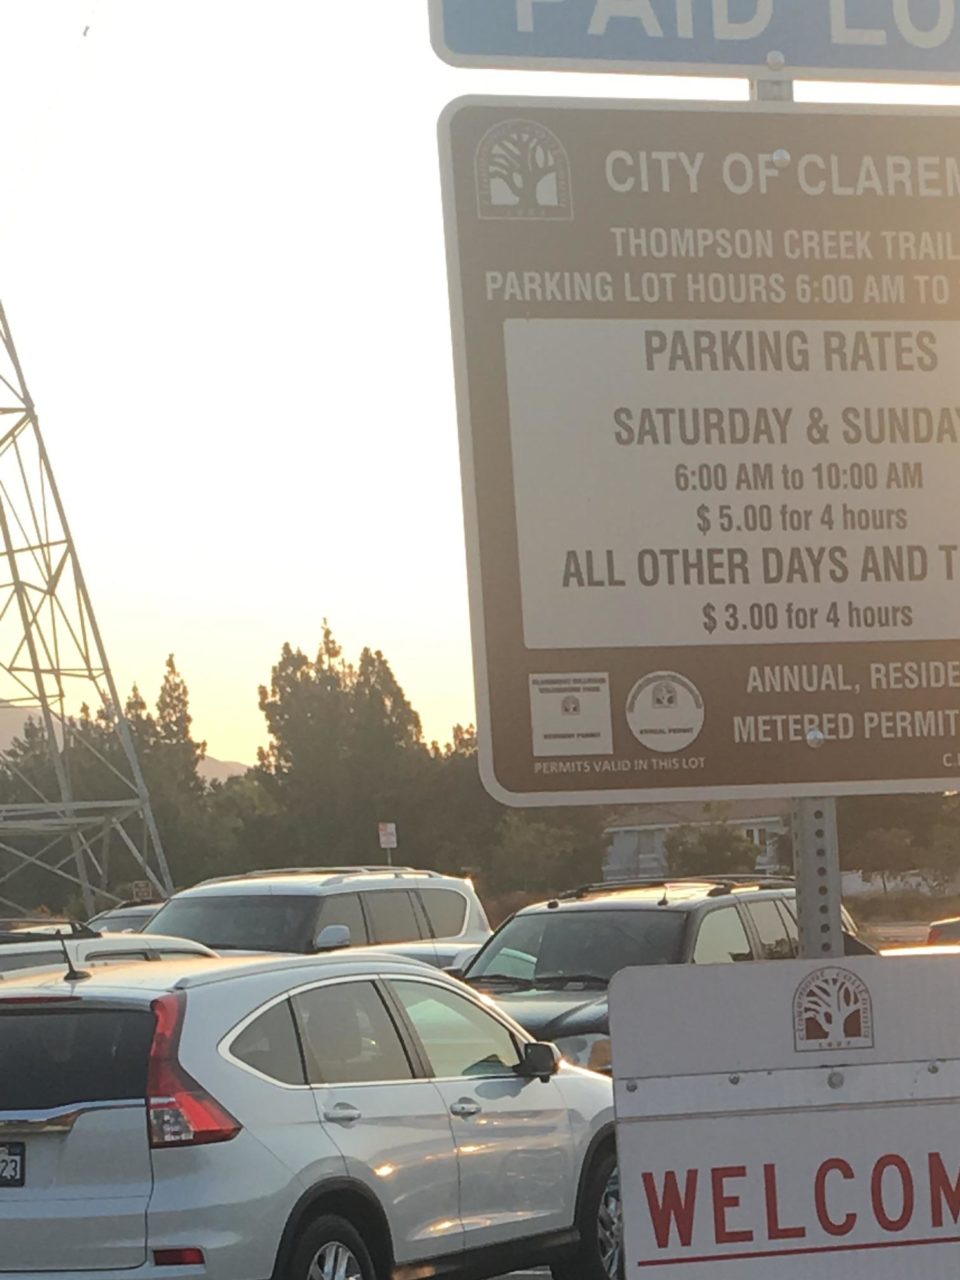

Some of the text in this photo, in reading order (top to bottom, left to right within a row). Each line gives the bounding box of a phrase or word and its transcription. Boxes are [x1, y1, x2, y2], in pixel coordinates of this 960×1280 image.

[605, 150, 704, 193] CITY
[722, 152, 782, 194] OF
[610, 227, 960, 261] THOMPSON CREEK TRAIL
[485, 271, 613, 301] PARKING
[624, 272, 677, 302] LOT
[687, 273, 786, 303] HOURS
[797, 274, 854, 304] 6:00
[863, 275, 905, 304] AM
[913, 275, 949, 304] TO
[644, 330, 938, 372] PARKING RATES
[614, 407, 792, 445] SATURDAY
[806, 407, 829, 445] &
[675, 462, 923, 491] 6:00 AM to 10:00 AM
[779, 504, 813, 531] for
[820, 504, 834, 530] 4
[842, 503, 907, 530] hours
[562, 550, 626, 587] ALL
[637, 548, 750, 586] OTHER
[761, 546, 849, 584] DAYS
[860, 545, 928, 582] AND
[785, 602, 818, 629] for
[826, 601, 840, 628] 4
[848, 601, 913, 628] hours
[747, 664, 860, 694] ANNUAL,
[733, 713, 854, 743] METERED
[864, 709, 959, 739] PERMIT
[534, 757, 706, 774] PERMITS VALID IN THIS LOT
